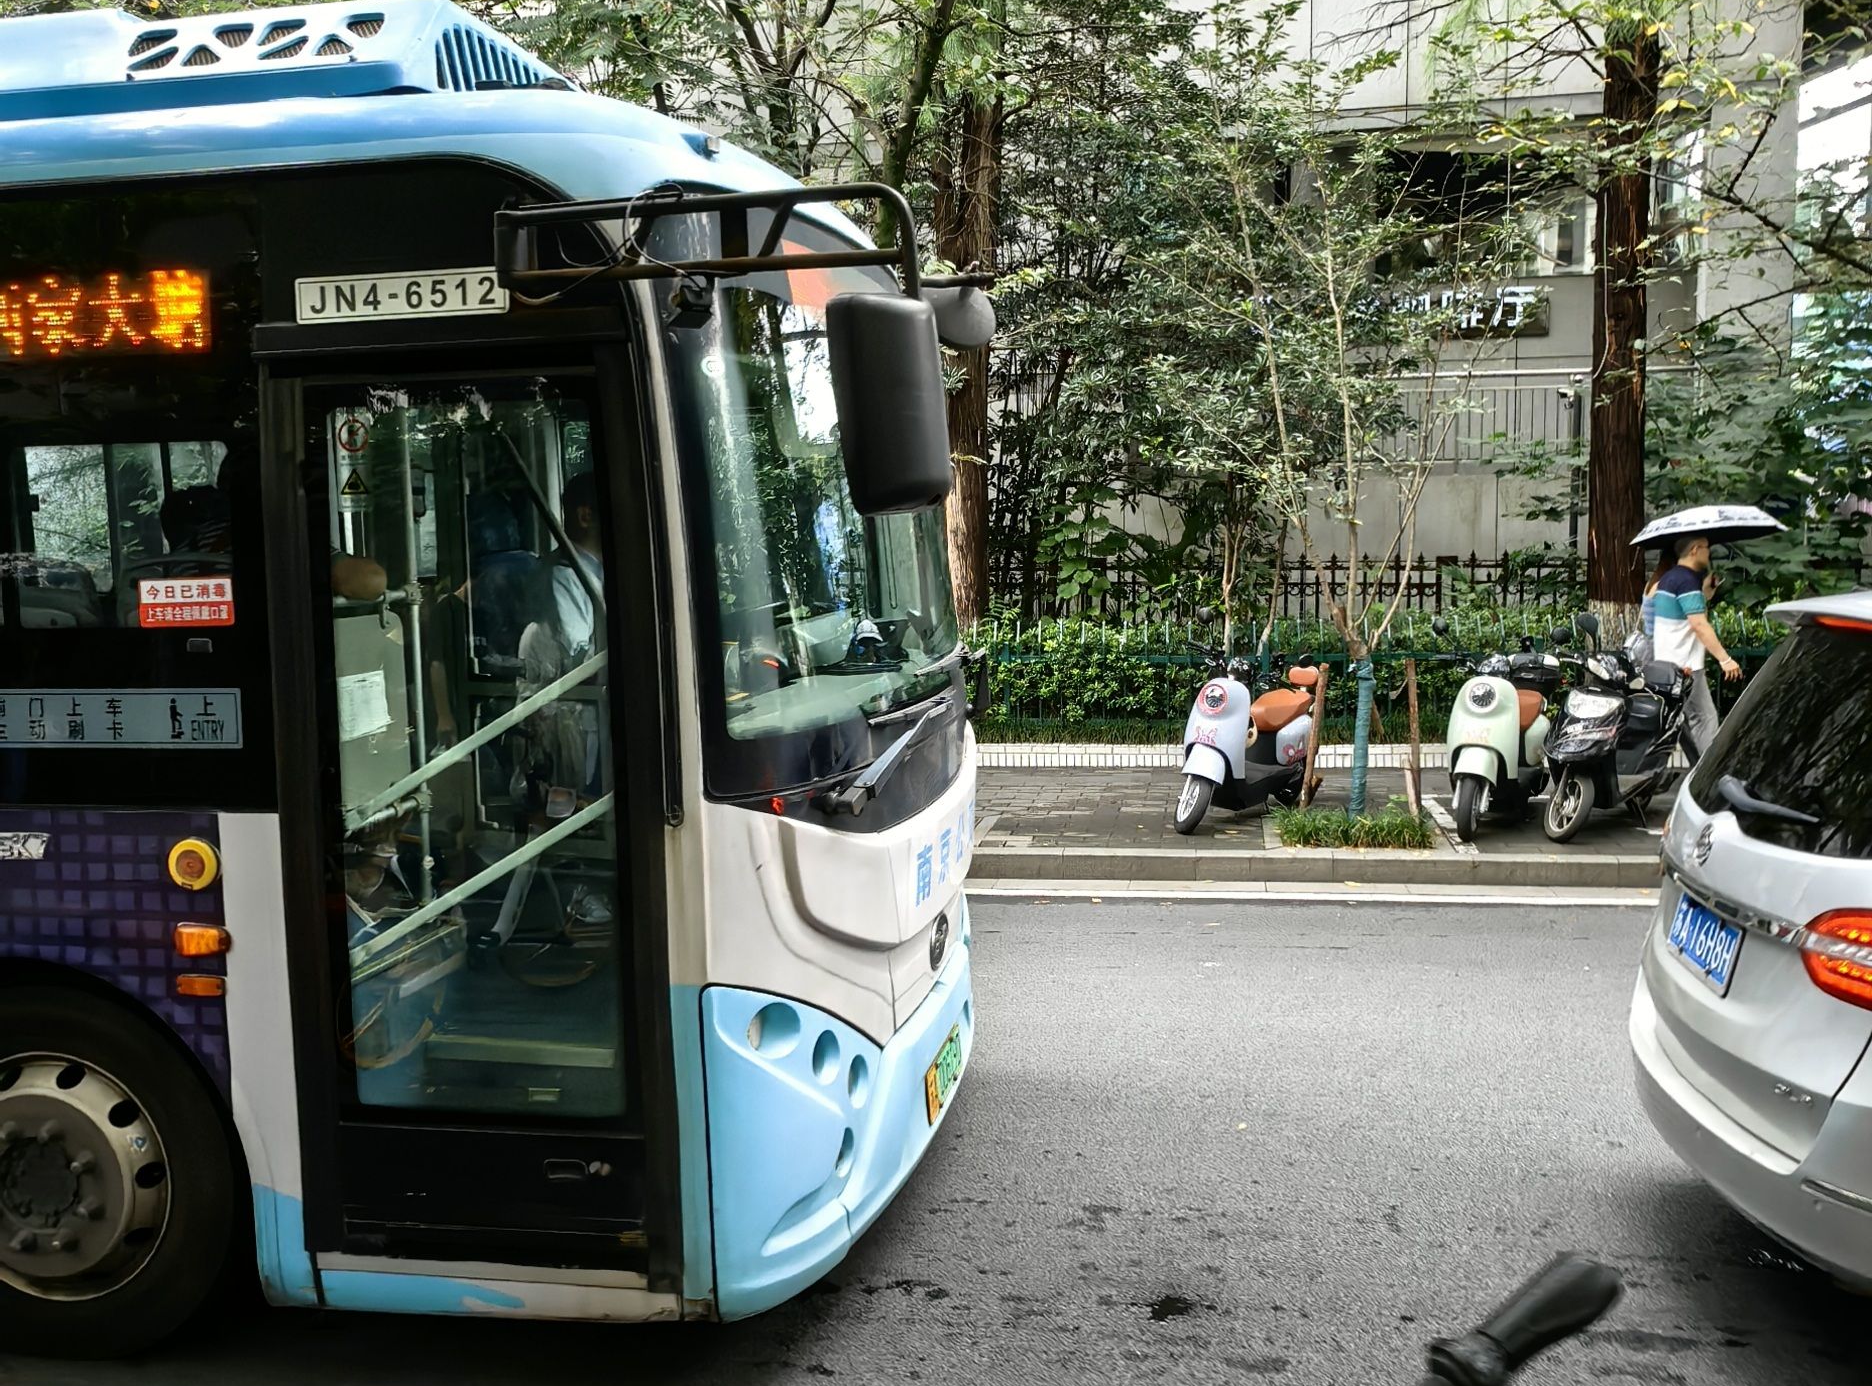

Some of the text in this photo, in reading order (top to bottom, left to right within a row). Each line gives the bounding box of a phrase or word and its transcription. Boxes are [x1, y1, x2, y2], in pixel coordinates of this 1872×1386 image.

[310, 276, 496, 314] JN4-6512
[146, 583, 226, 600] 今日已消毒
[196, 696, 216, 716] 上
[191, 720, 224, 741] ENTRY
